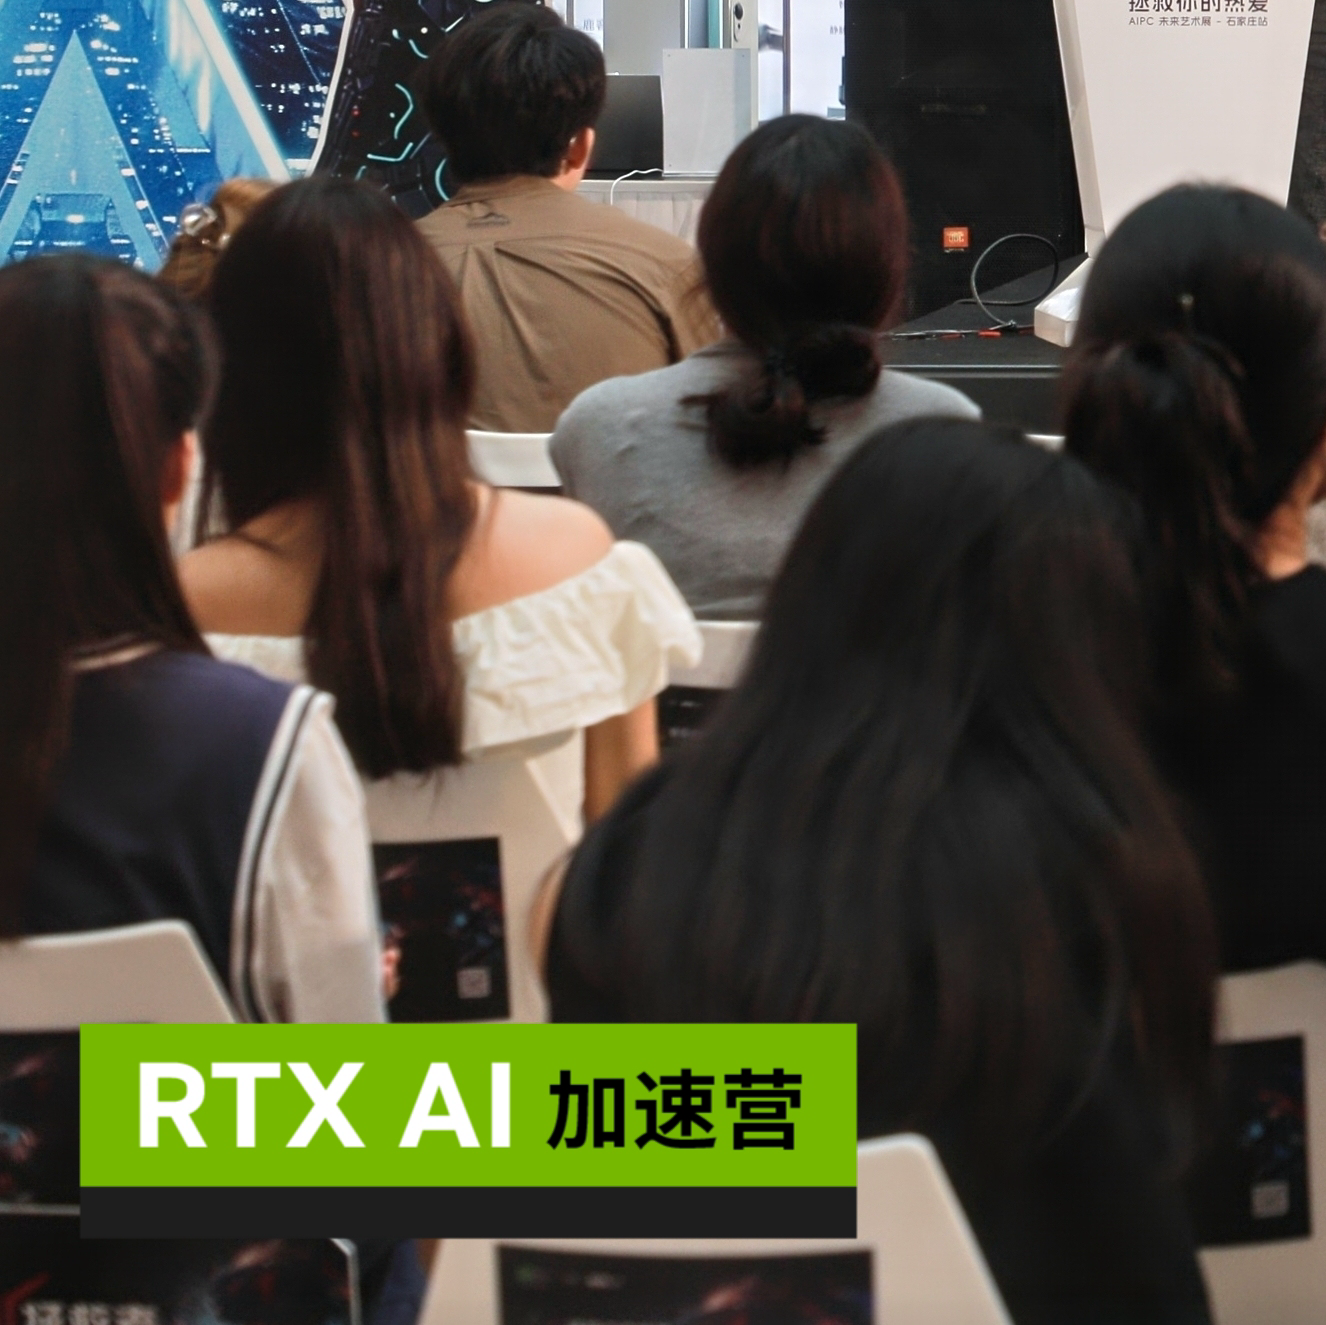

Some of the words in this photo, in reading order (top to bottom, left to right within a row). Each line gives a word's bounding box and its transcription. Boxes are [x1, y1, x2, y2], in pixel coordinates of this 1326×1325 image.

[1129, 16, 1155, 26] AIPC
[1158, 16, 1212, 27] 未来艺术展
[1226, 16, 1269, 27] 石家庄站
